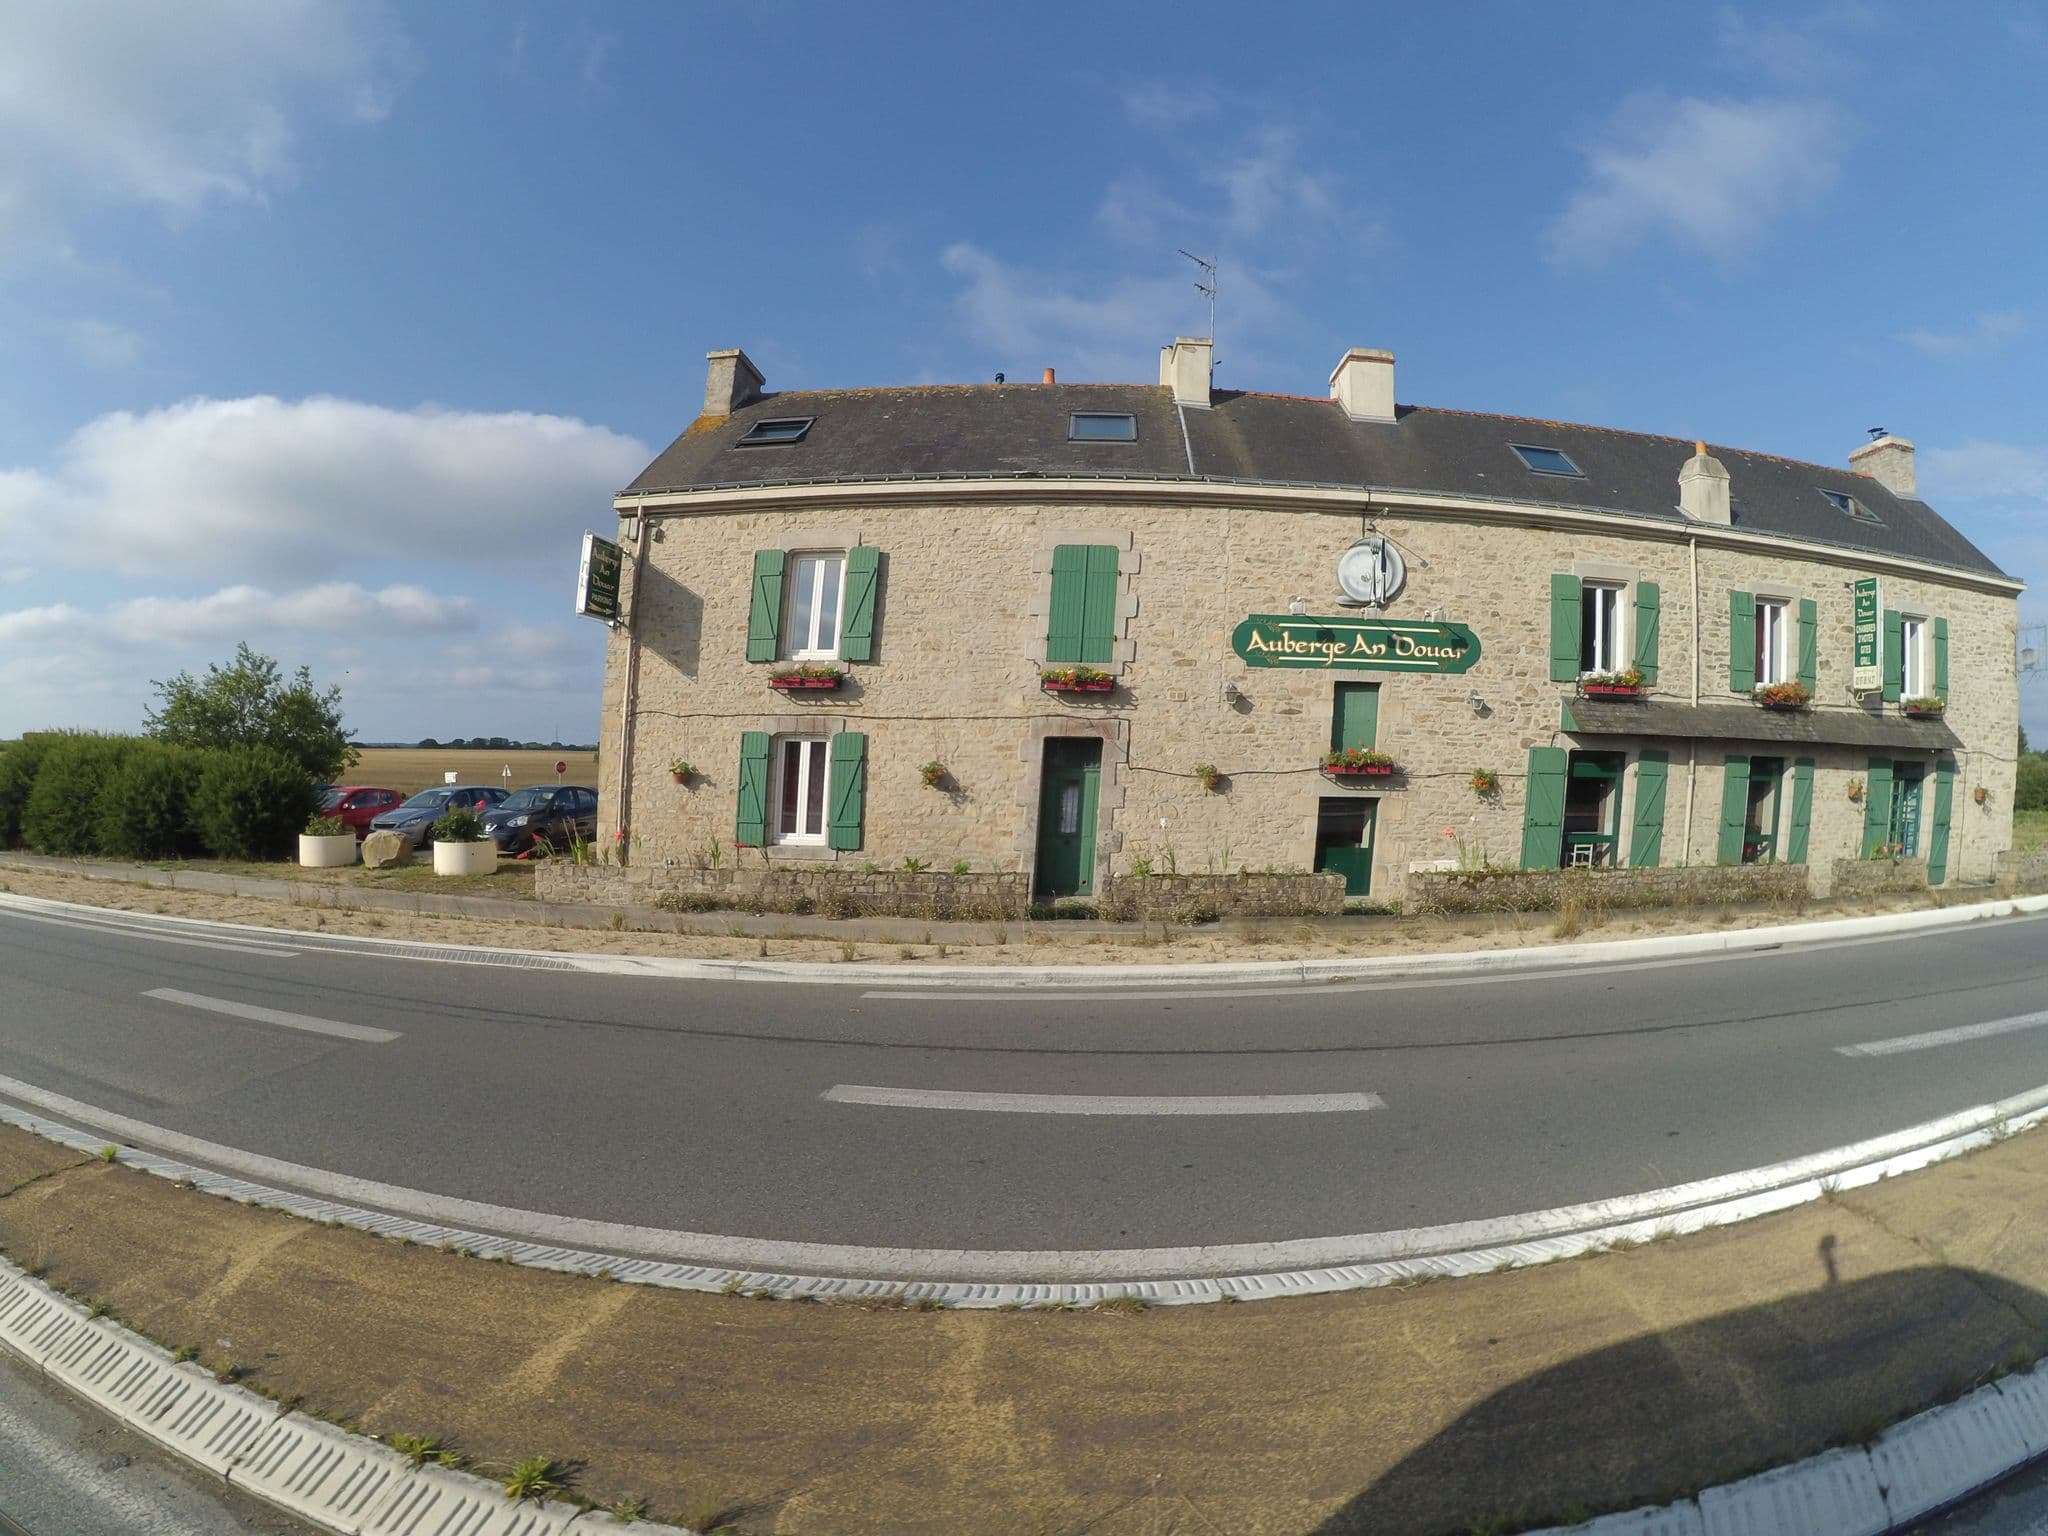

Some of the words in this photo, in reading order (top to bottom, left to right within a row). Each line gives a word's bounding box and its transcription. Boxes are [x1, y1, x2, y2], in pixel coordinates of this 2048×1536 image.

[600, 563, 610, 576] An
[592, 573, 615, 591] Douar
[1246, 629, 1348, 666] Auberge
[1350, 633, 1386, 655] An
[1394, 633, 1466, 658] Douar
